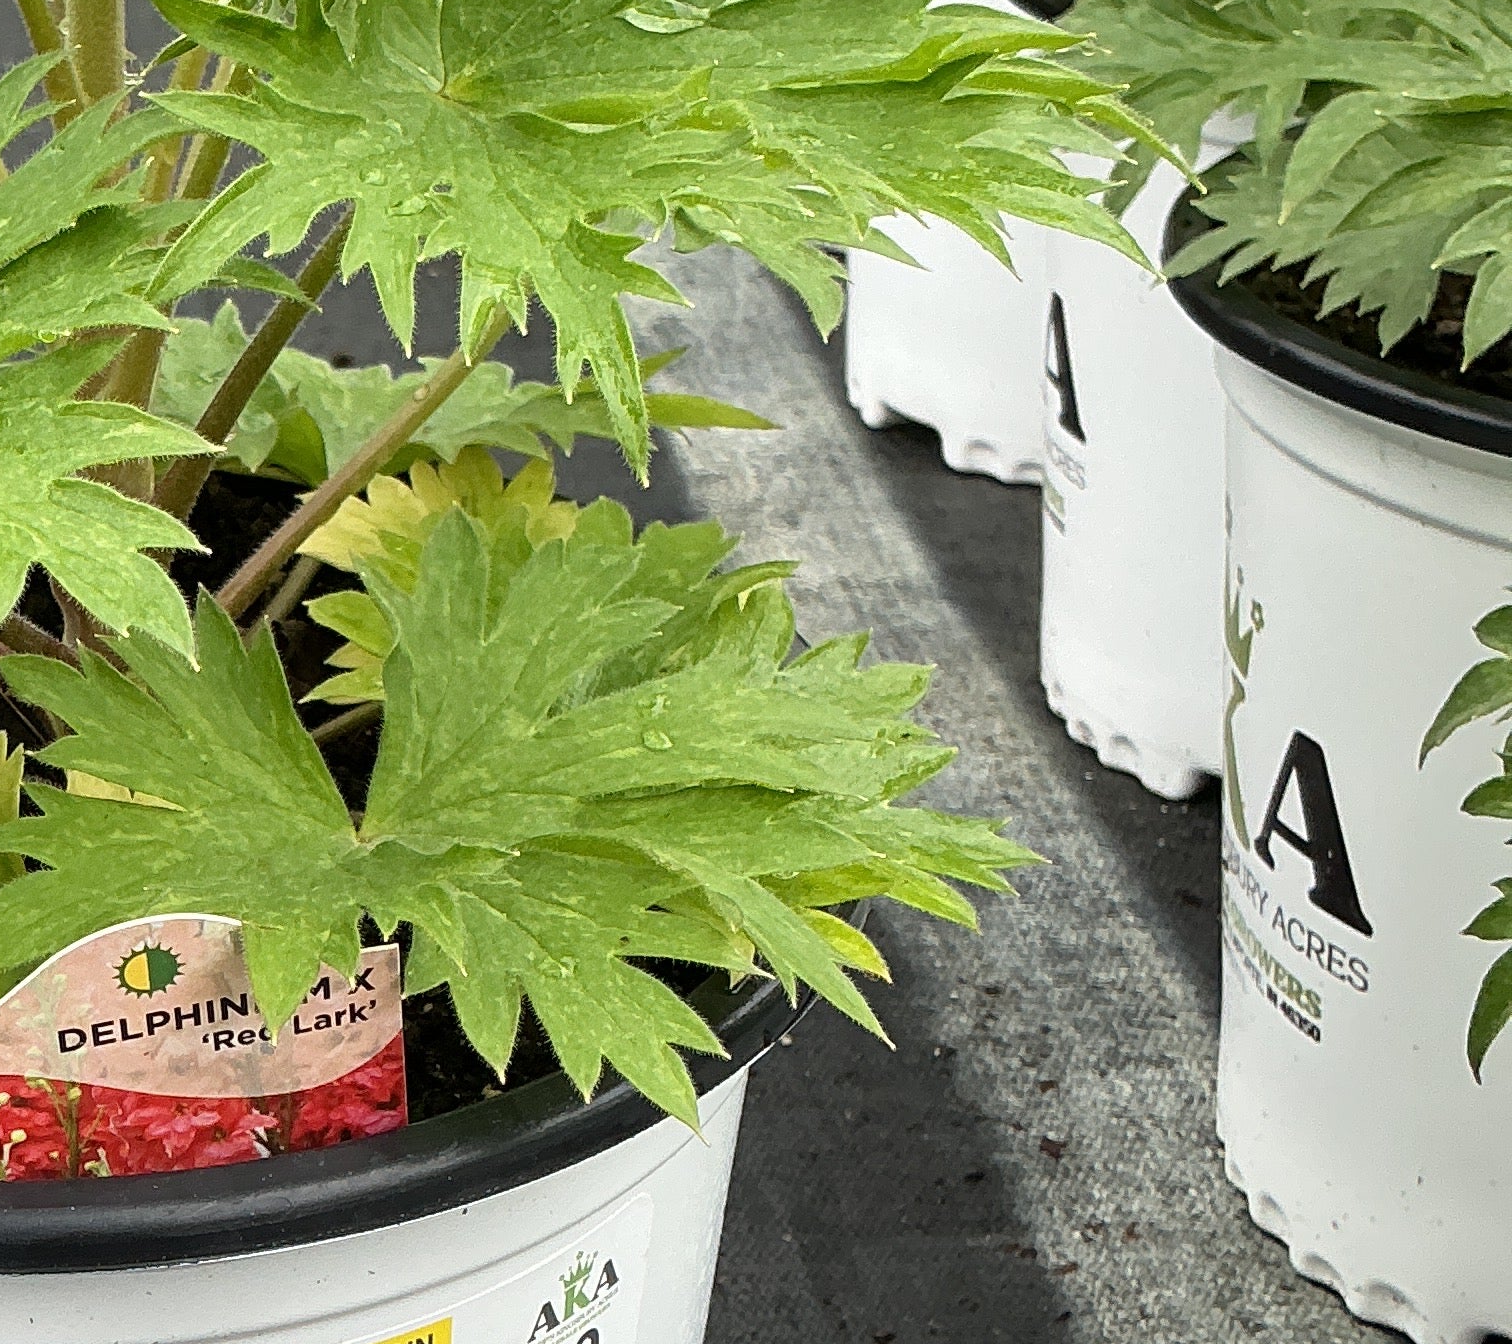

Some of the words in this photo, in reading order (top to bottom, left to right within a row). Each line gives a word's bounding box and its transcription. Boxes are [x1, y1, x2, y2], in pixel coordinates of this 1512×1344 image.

[1272, 905, 1370, 994] ACRES
[57, 976, 331, 1054] DELPHINM
[527, 1258, 619, 1344] AKA
